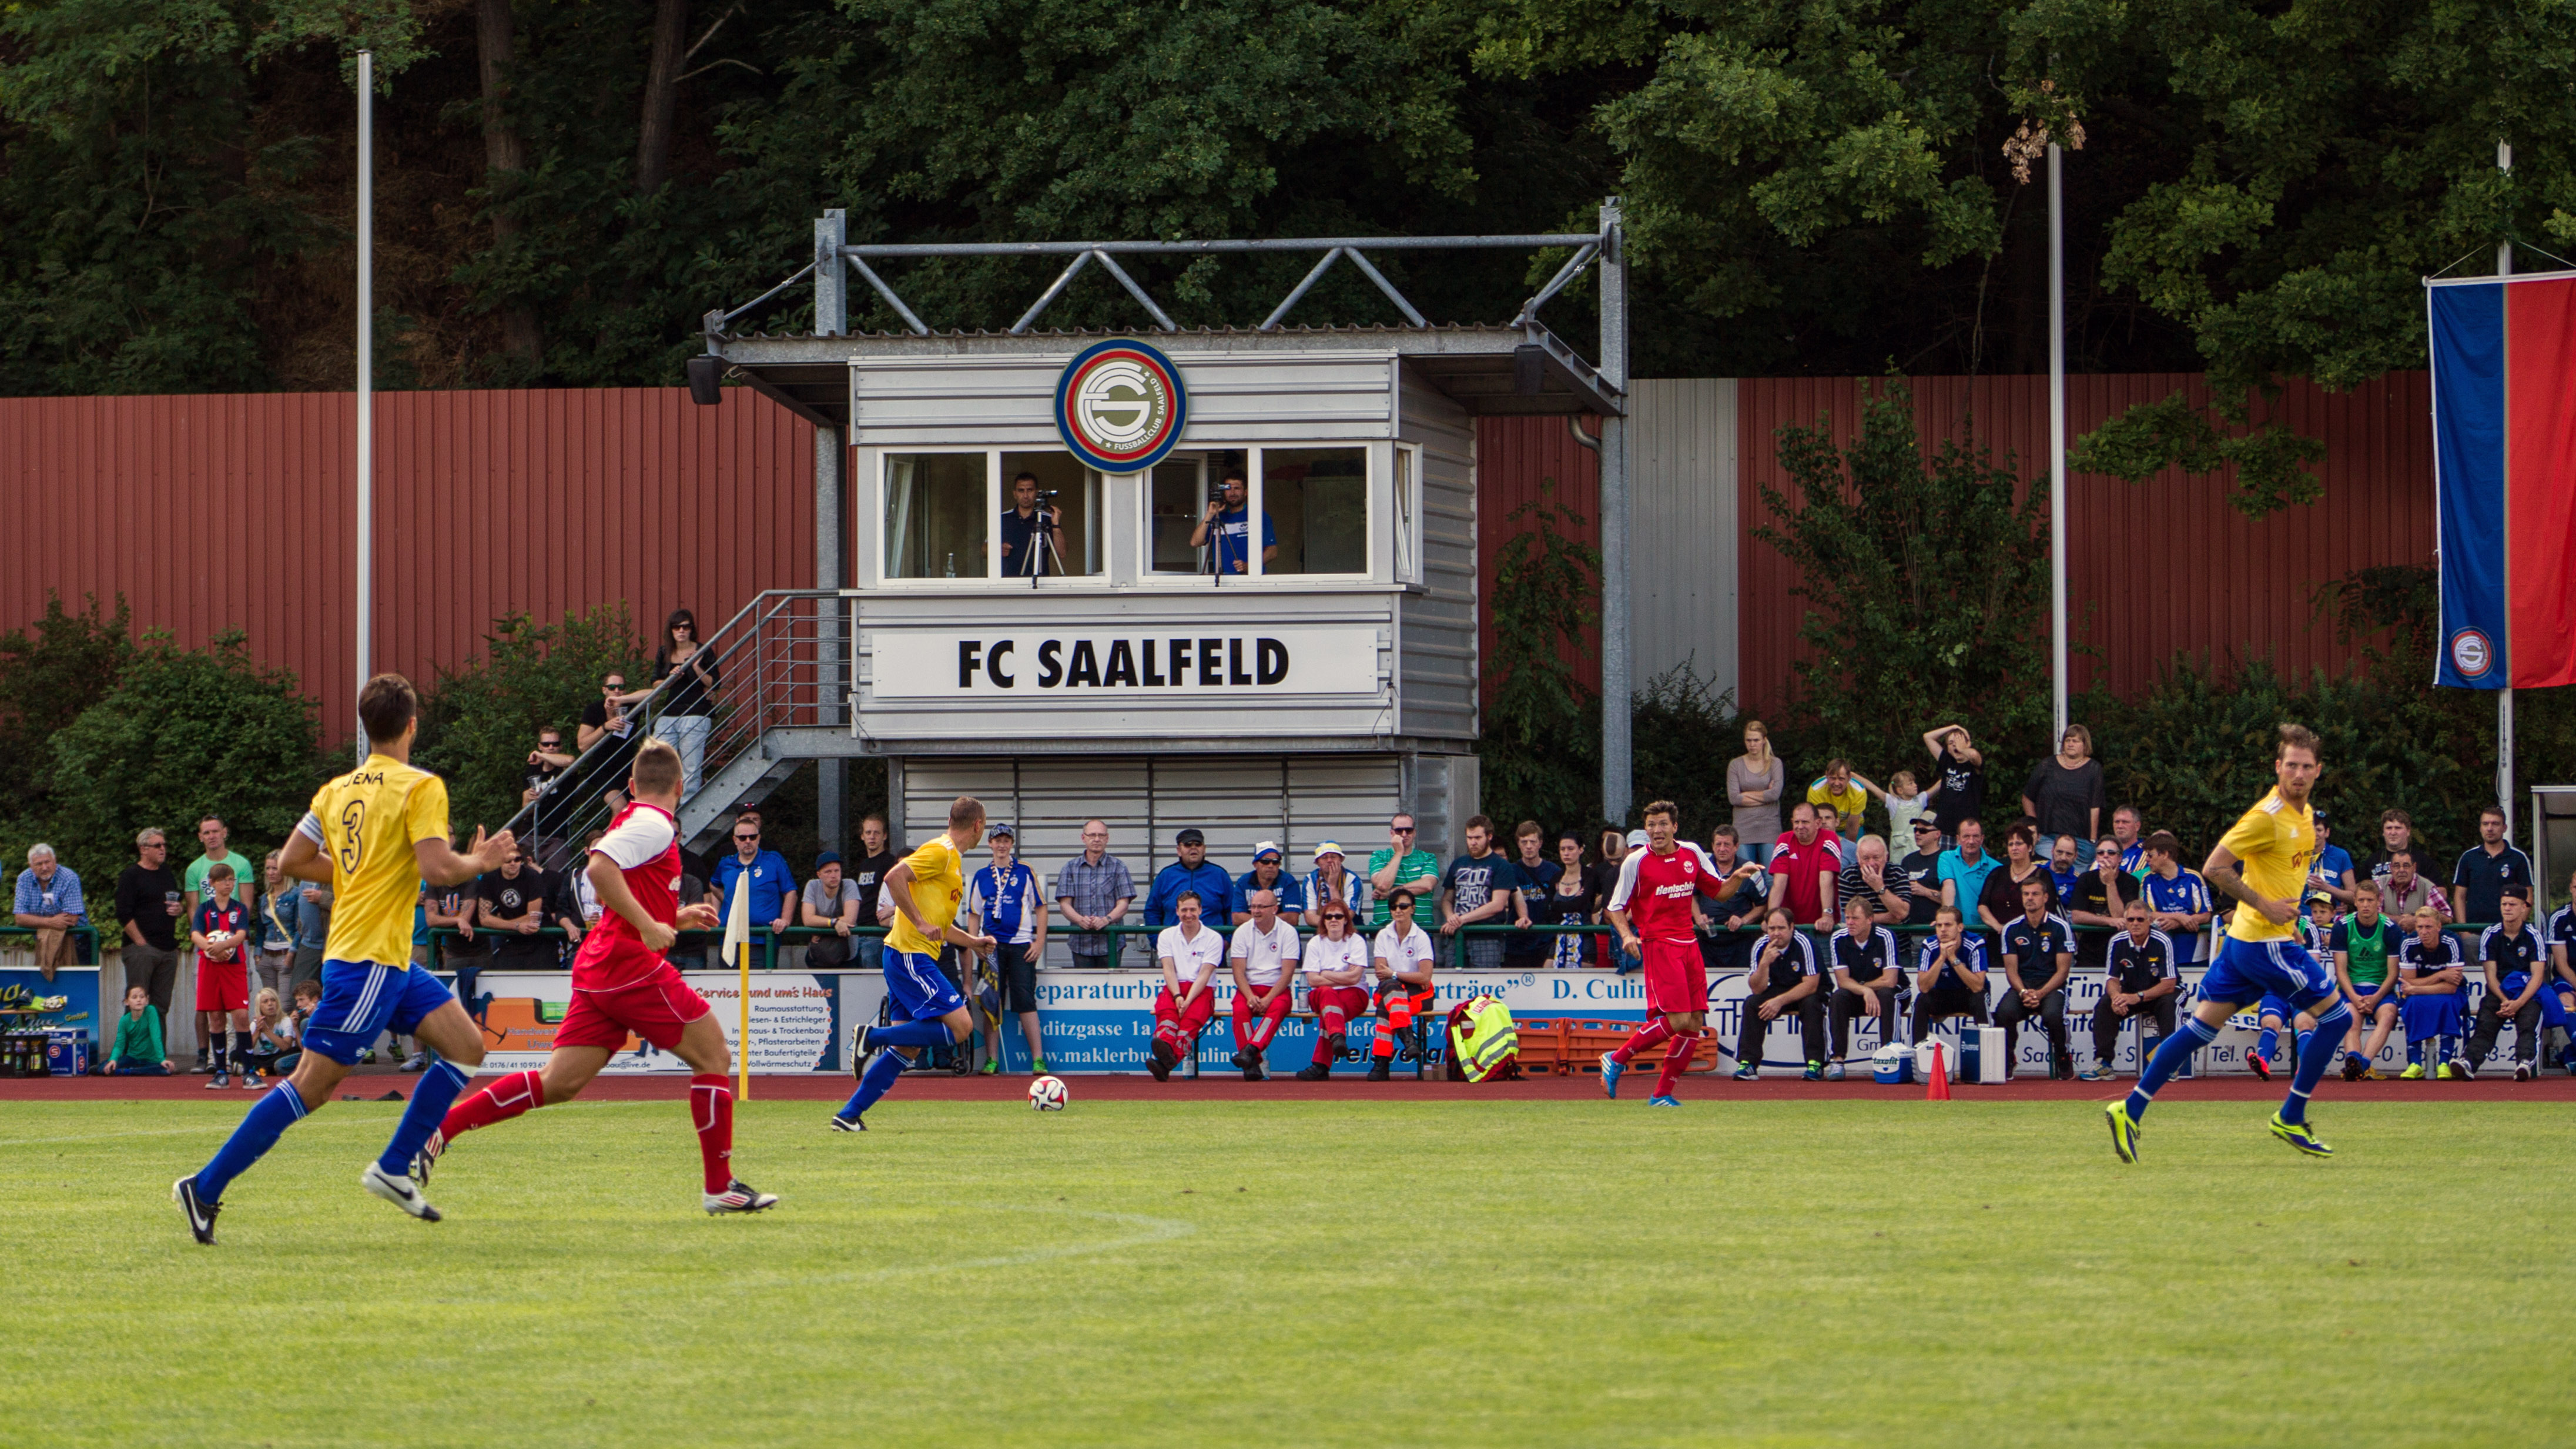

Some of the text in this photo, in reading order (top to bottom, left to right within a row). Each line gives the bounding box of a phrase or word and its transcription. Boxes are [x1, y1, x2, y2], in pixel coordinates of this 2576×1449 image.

[1114, 377, 1165, 450] FUSSBALLCLUB SAALFELD
[959, 637, 1289, 688] FC SAALFELD
[344, 772, 384, 788] JENA
[341, 799, 365, 875] 3
[1455, 868, 1489, 886] ZOO
[696, 988, 739, 998] Service
[748, 988, 771, 998] und
[802, 988, 832, 998] Haus
[1552, 979, 1577, 999] D.
[748, 1015, 772, 1023] iesen-
[780, 1015, 826, 1025] Estrichleger
[758, 1038, 820, 1046] Pflasterarbeiten
[764, 1049, 817, 1059] Baufertigteile
[2212, 1046, 2239, 1062] Tel.
[748, 1059, 812, 1067] Vollwärmeschutz
